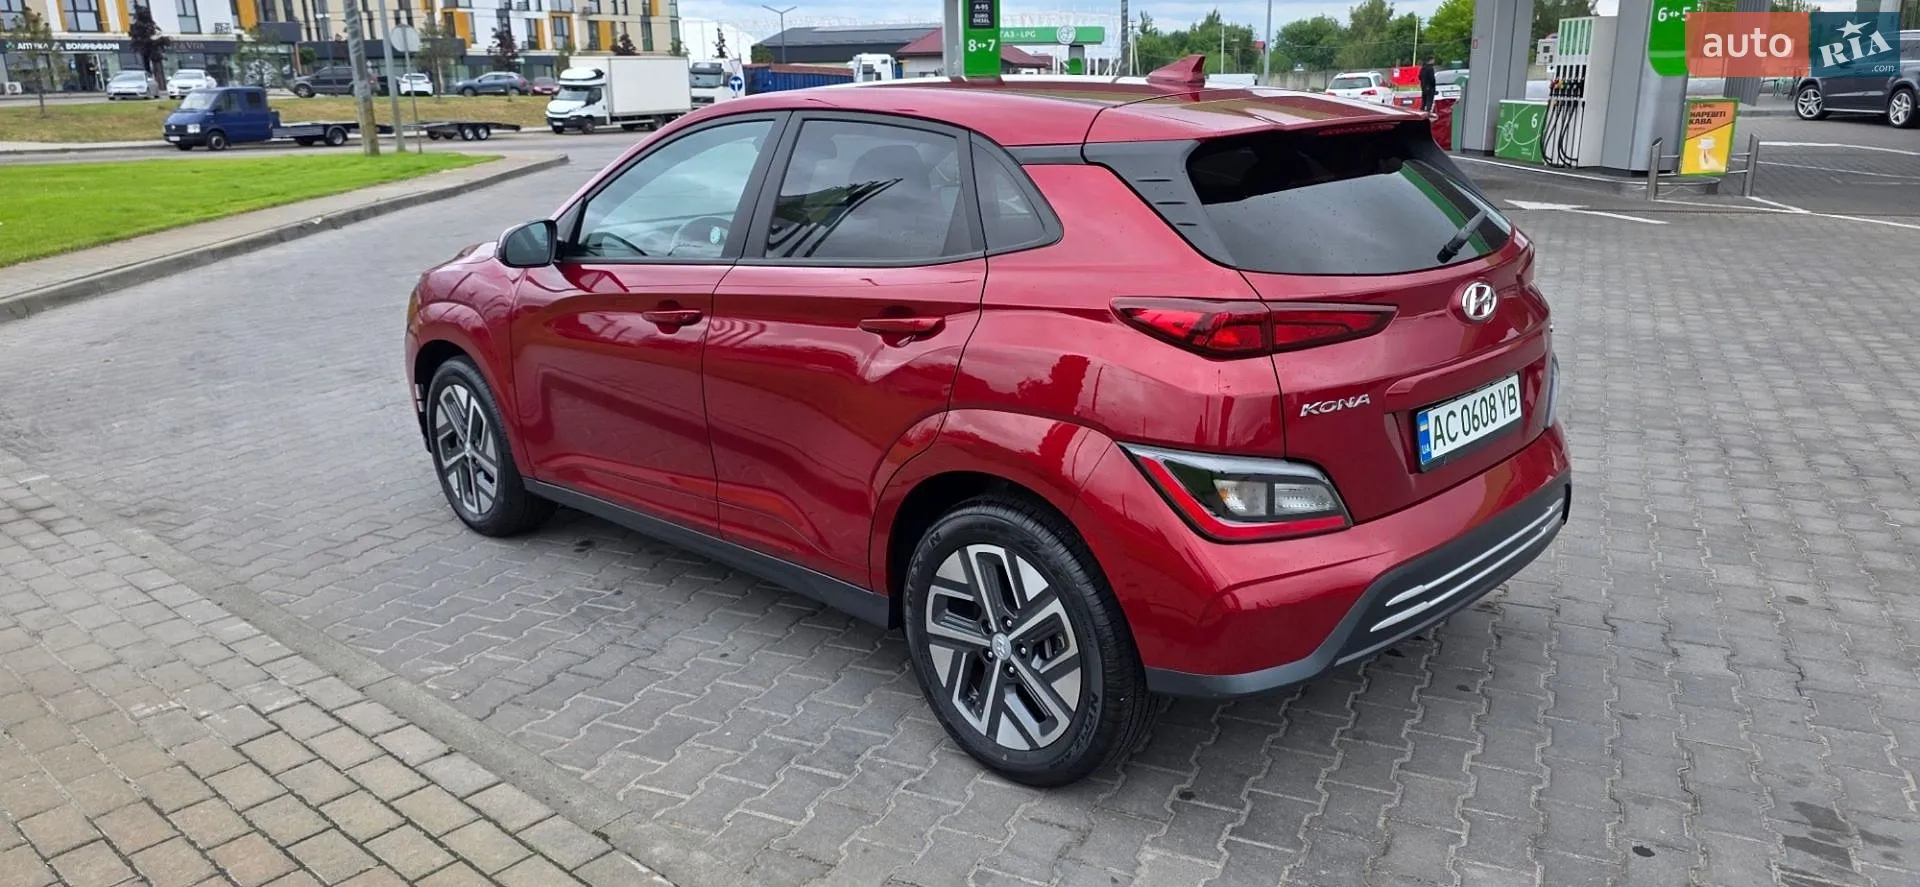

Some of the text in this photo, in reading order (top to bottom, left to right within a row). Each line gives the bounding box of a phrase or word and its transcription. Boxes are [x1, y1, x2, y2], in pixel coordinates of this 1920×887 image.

[1658, 6, 1668, 21] 6
[1020, 30, 1036, 38] LPG
[968, 39, 996, 52] 8 7
[1531, 112, 1539, 128] 6
[1300, 393, 1371, 417] KONA
[1433, 383, 1518, 450] AC 0608 YB
